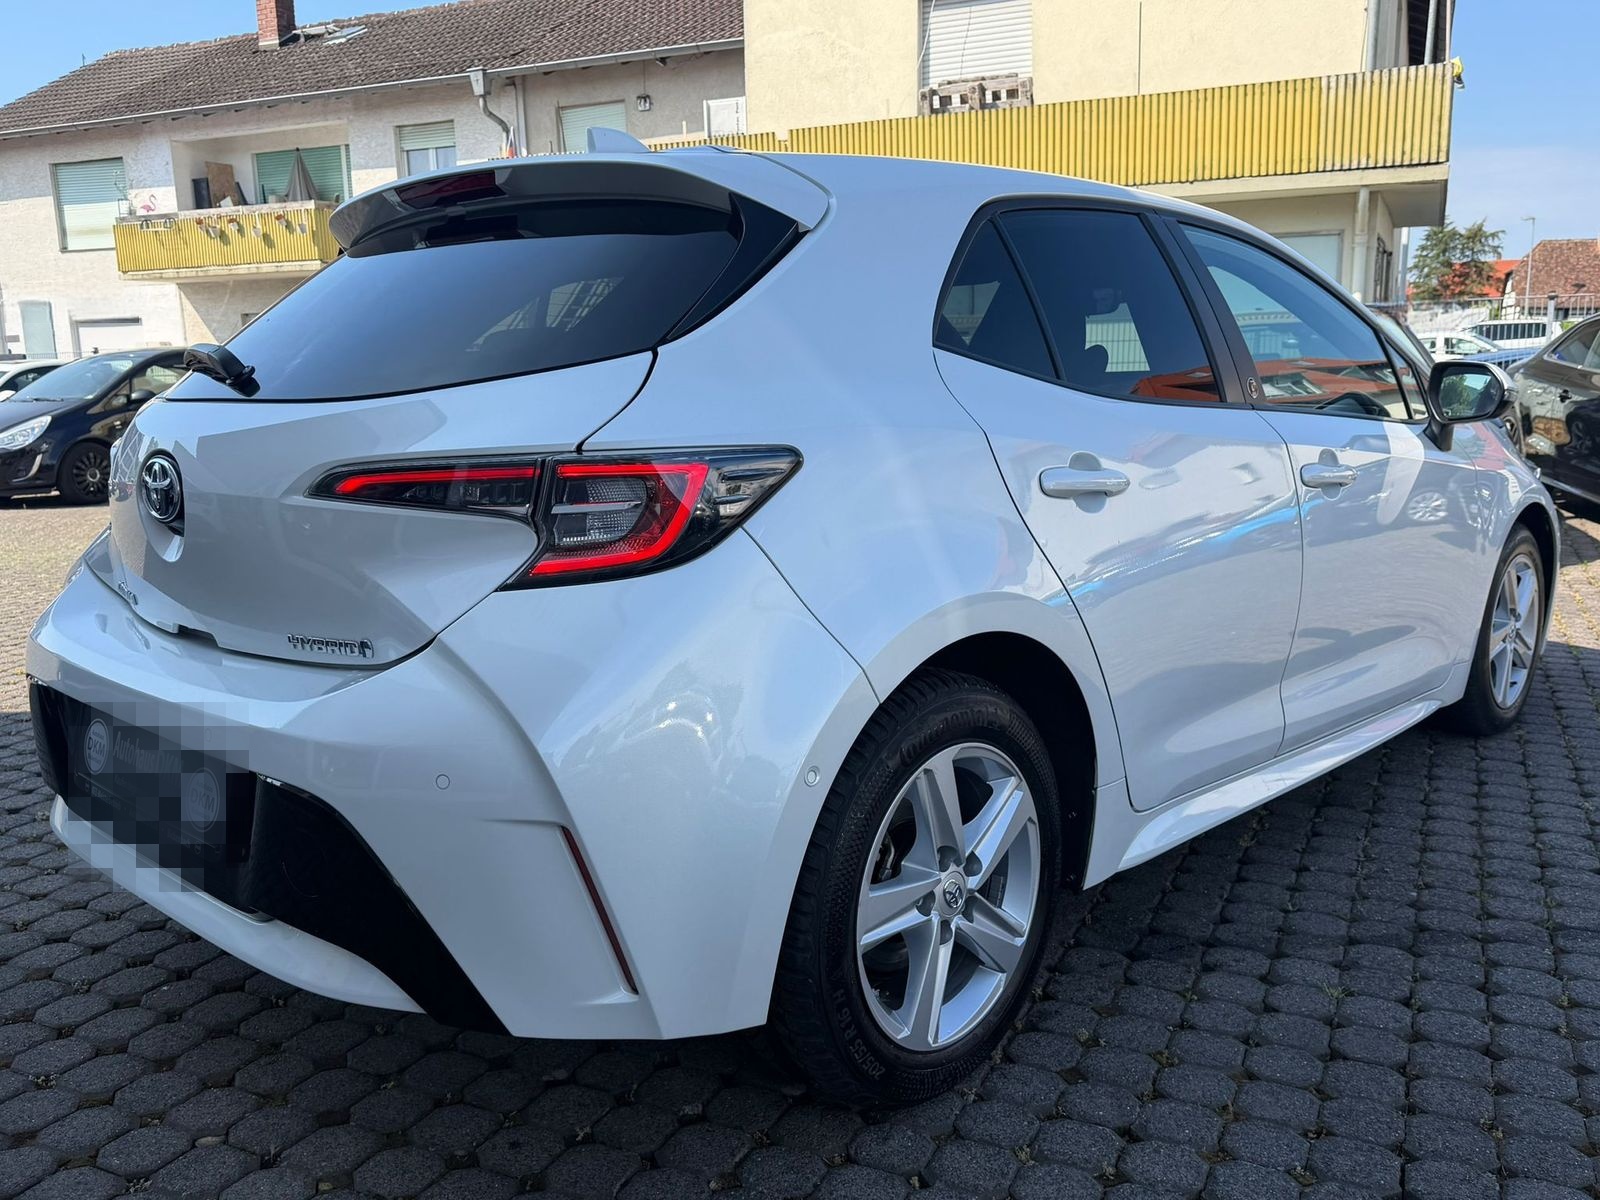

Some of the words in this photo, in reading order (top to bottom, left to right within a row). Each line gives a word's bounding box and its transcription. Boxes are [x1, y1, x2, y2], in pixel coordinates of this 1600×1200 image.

[287, 634, 359, 656] HYBRID
[87, 736, 106, 758] DKM
[190, 787, 215, 814] DKM
[838, 1007, 852, 1028] 16
[844, 1023, 858, 1040] R
[848, 1038, 886, 1081] 205/55
